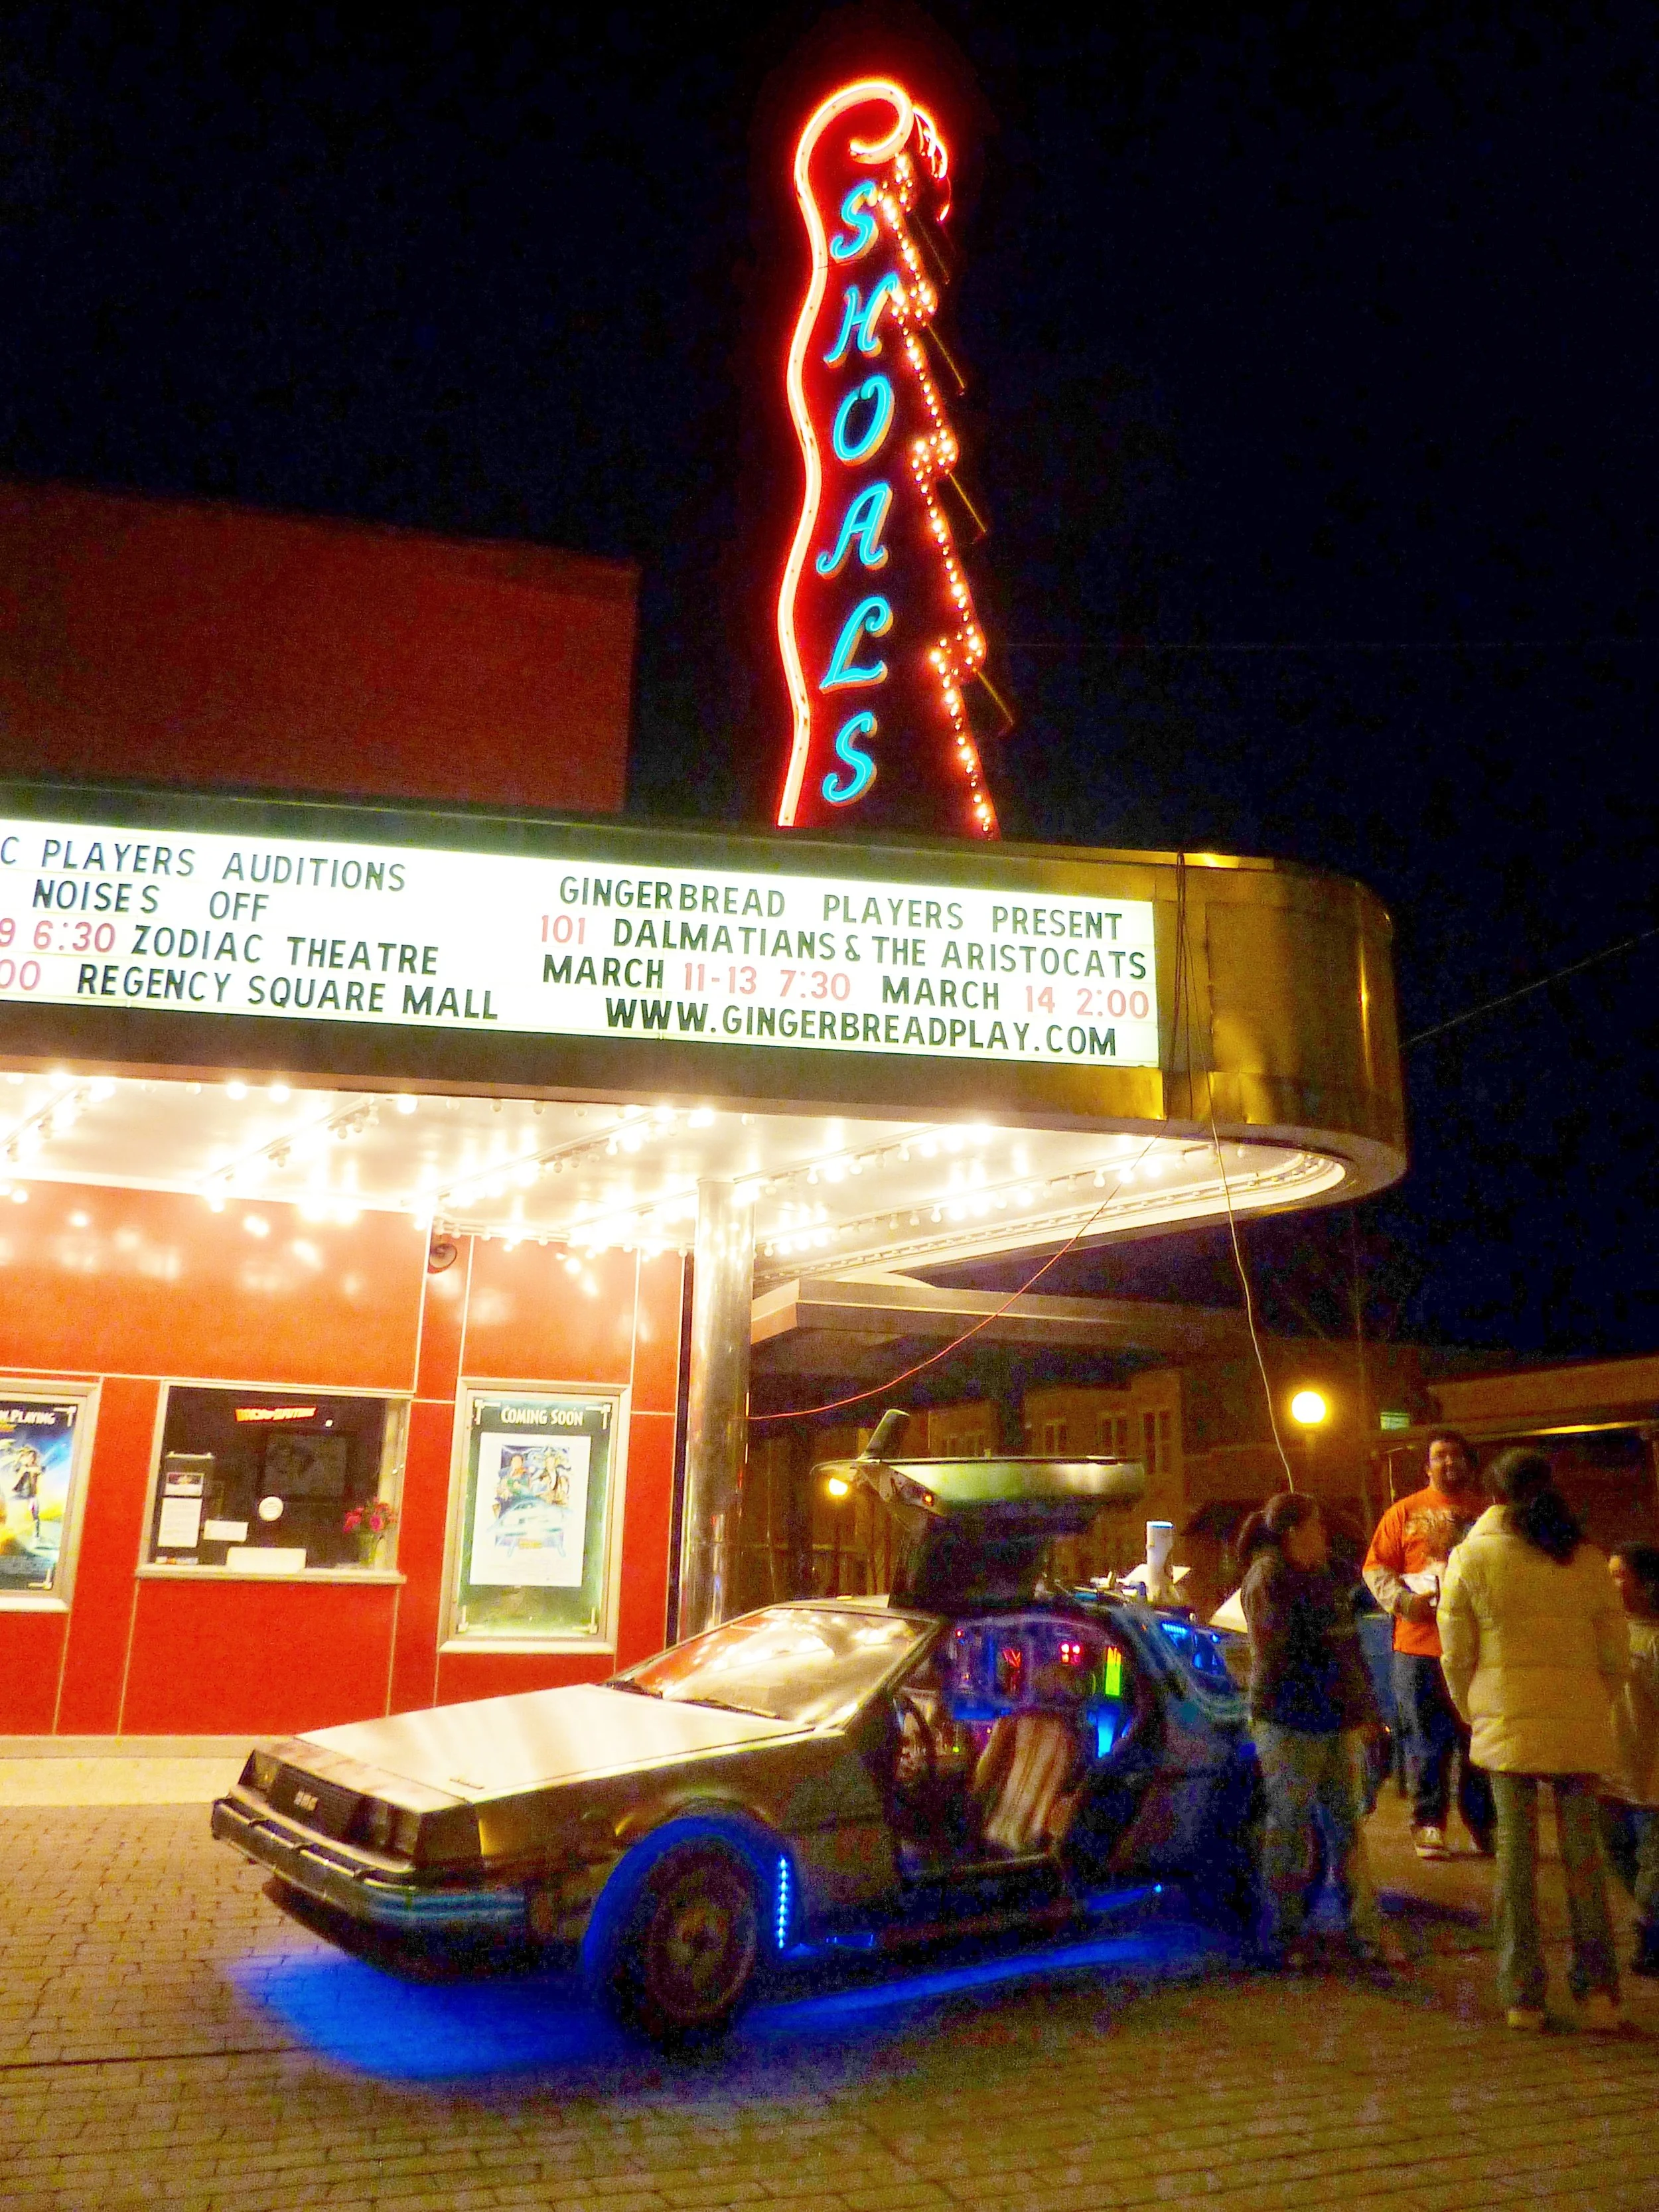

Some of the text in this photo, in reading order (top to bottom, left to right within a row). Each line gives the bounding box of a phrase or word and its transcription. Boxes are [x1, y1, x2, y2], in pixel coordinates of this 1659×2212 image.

[816, 180, 899, 806] SHOALS
[41, 840, 195, 877] PLAYERS
[222, 853, 405, 892] AUDITIONS
[32, 879, 269, 922] NOISES OFF
[560, 877, 1123, 940] GINGERBREAD PLAYERS PRESENT
[33, 920, 115, 953] 6:30
[131, 924, 263, 964] ZODIAC
[287, 936, 439, 976] THEATRE
[541, 915, 585, 944] 101
[614, 919, 835, 961] DALMATIANS
[872, 936, 926, 967] THE
[942, 941, 1147, 980] ARISTOCATS
[77, 964, 232, 1002] REGENCY
[248, 976, 386, 1013] SQUARE
[402, 985, 498, 1021] MALL
[543, 954, 1149, 1019] MARCH 11-13 7:30 MARCH 14 2:00
[606, 998, 1116, 1057] WWW.GINGERBREADPLAY.COM
[10, 1409, 56, 1425] PLAYING
[501, 1405, 583, 1426] COMING SOON
